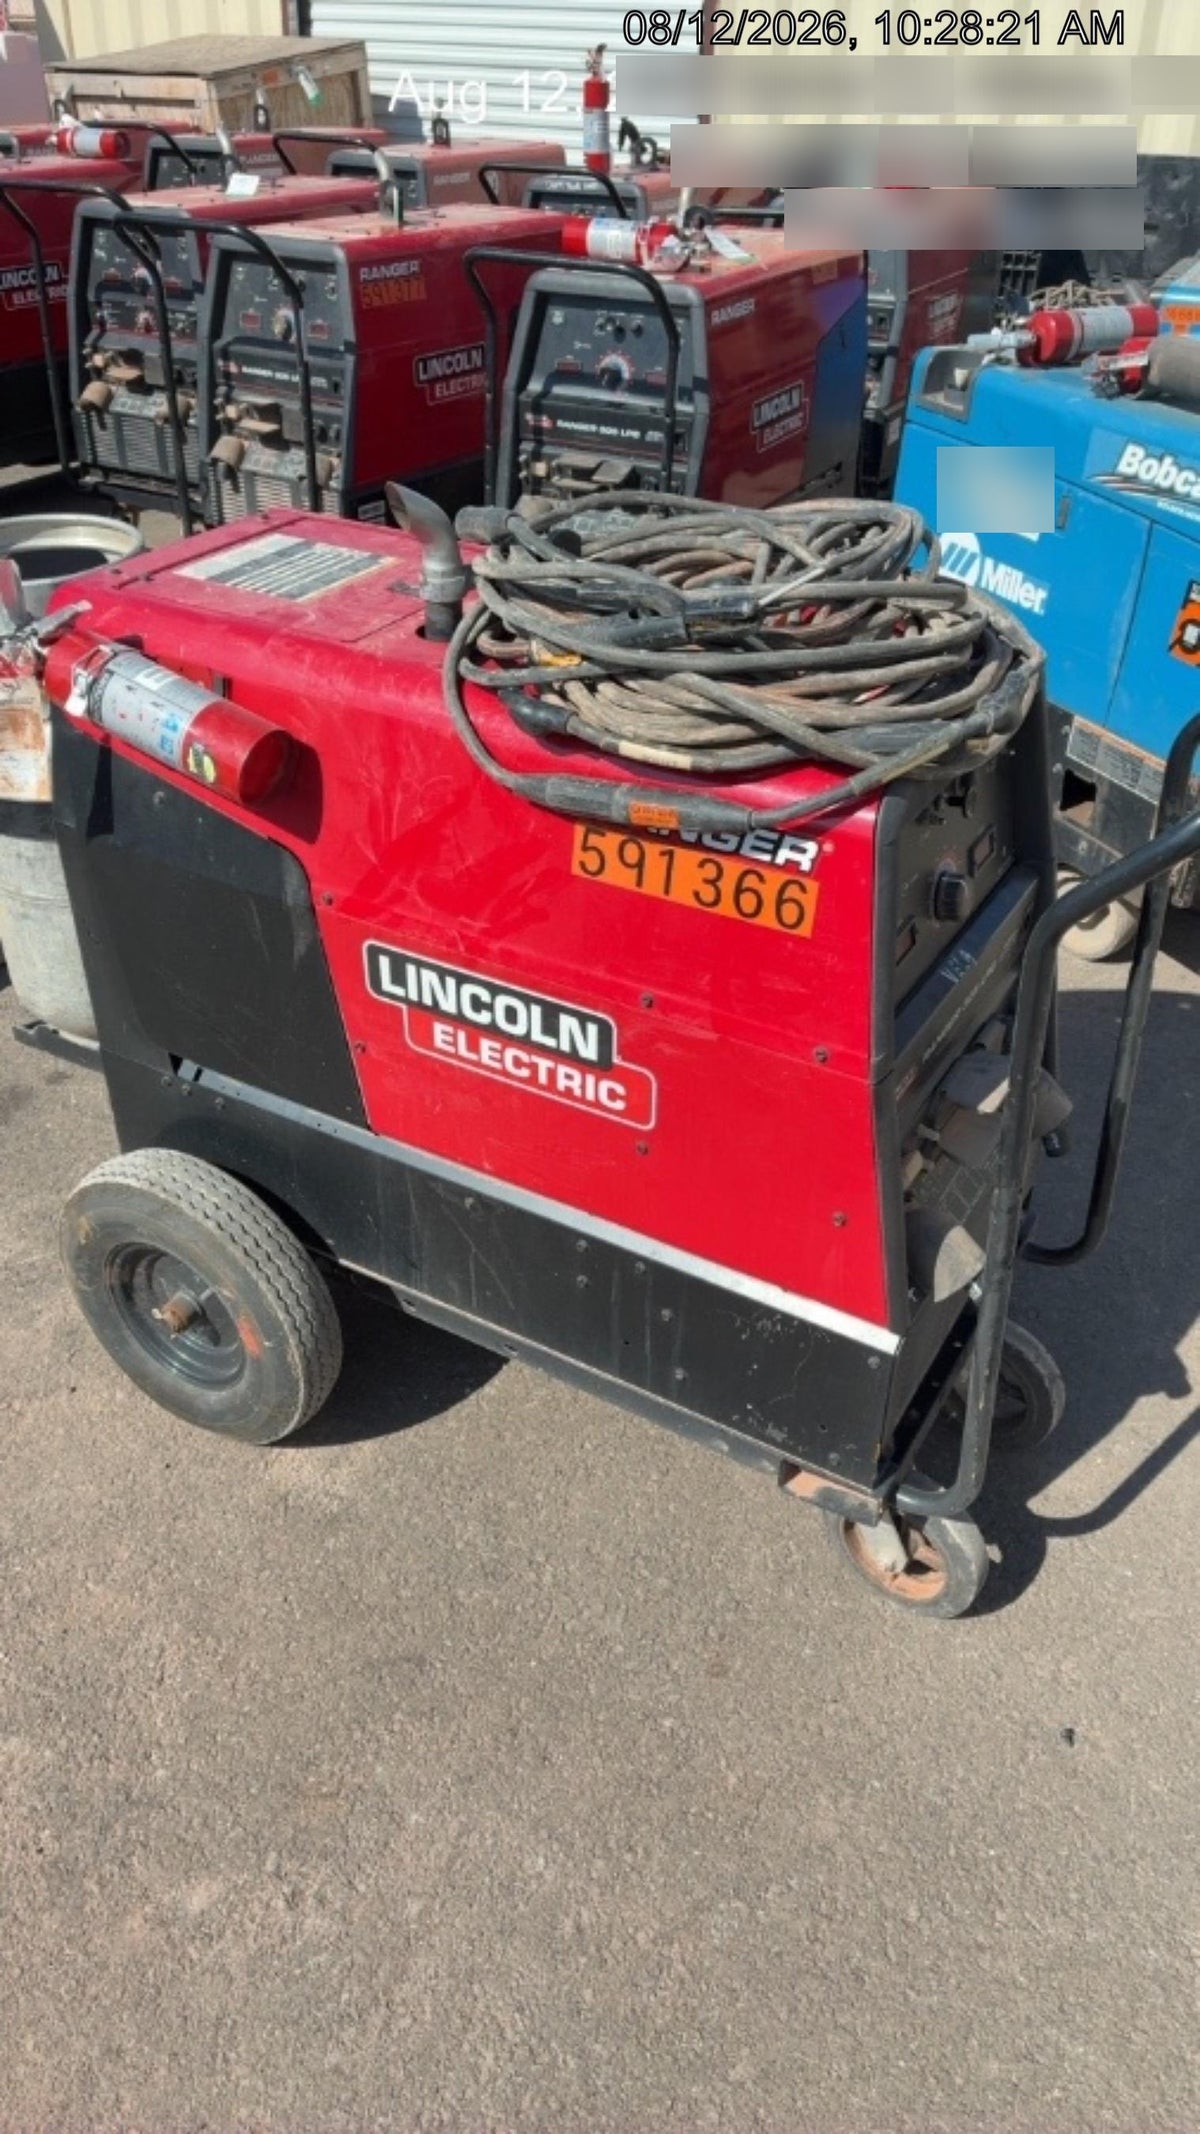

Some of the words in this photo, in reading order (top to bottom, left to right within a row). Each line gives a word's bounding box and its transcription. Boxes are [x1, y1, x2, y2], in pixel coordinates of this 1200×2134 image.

[360, 260, 421, 282] RANGER
[418, 347, 483, 381] LINCOLN
[980, 556, 1048, 614] Miller
[578, 824, 808, 931] 591366
[378, 955, 599, 1062] LINCOLN
[432, 1021, 627, 1111] ELECTRIC
